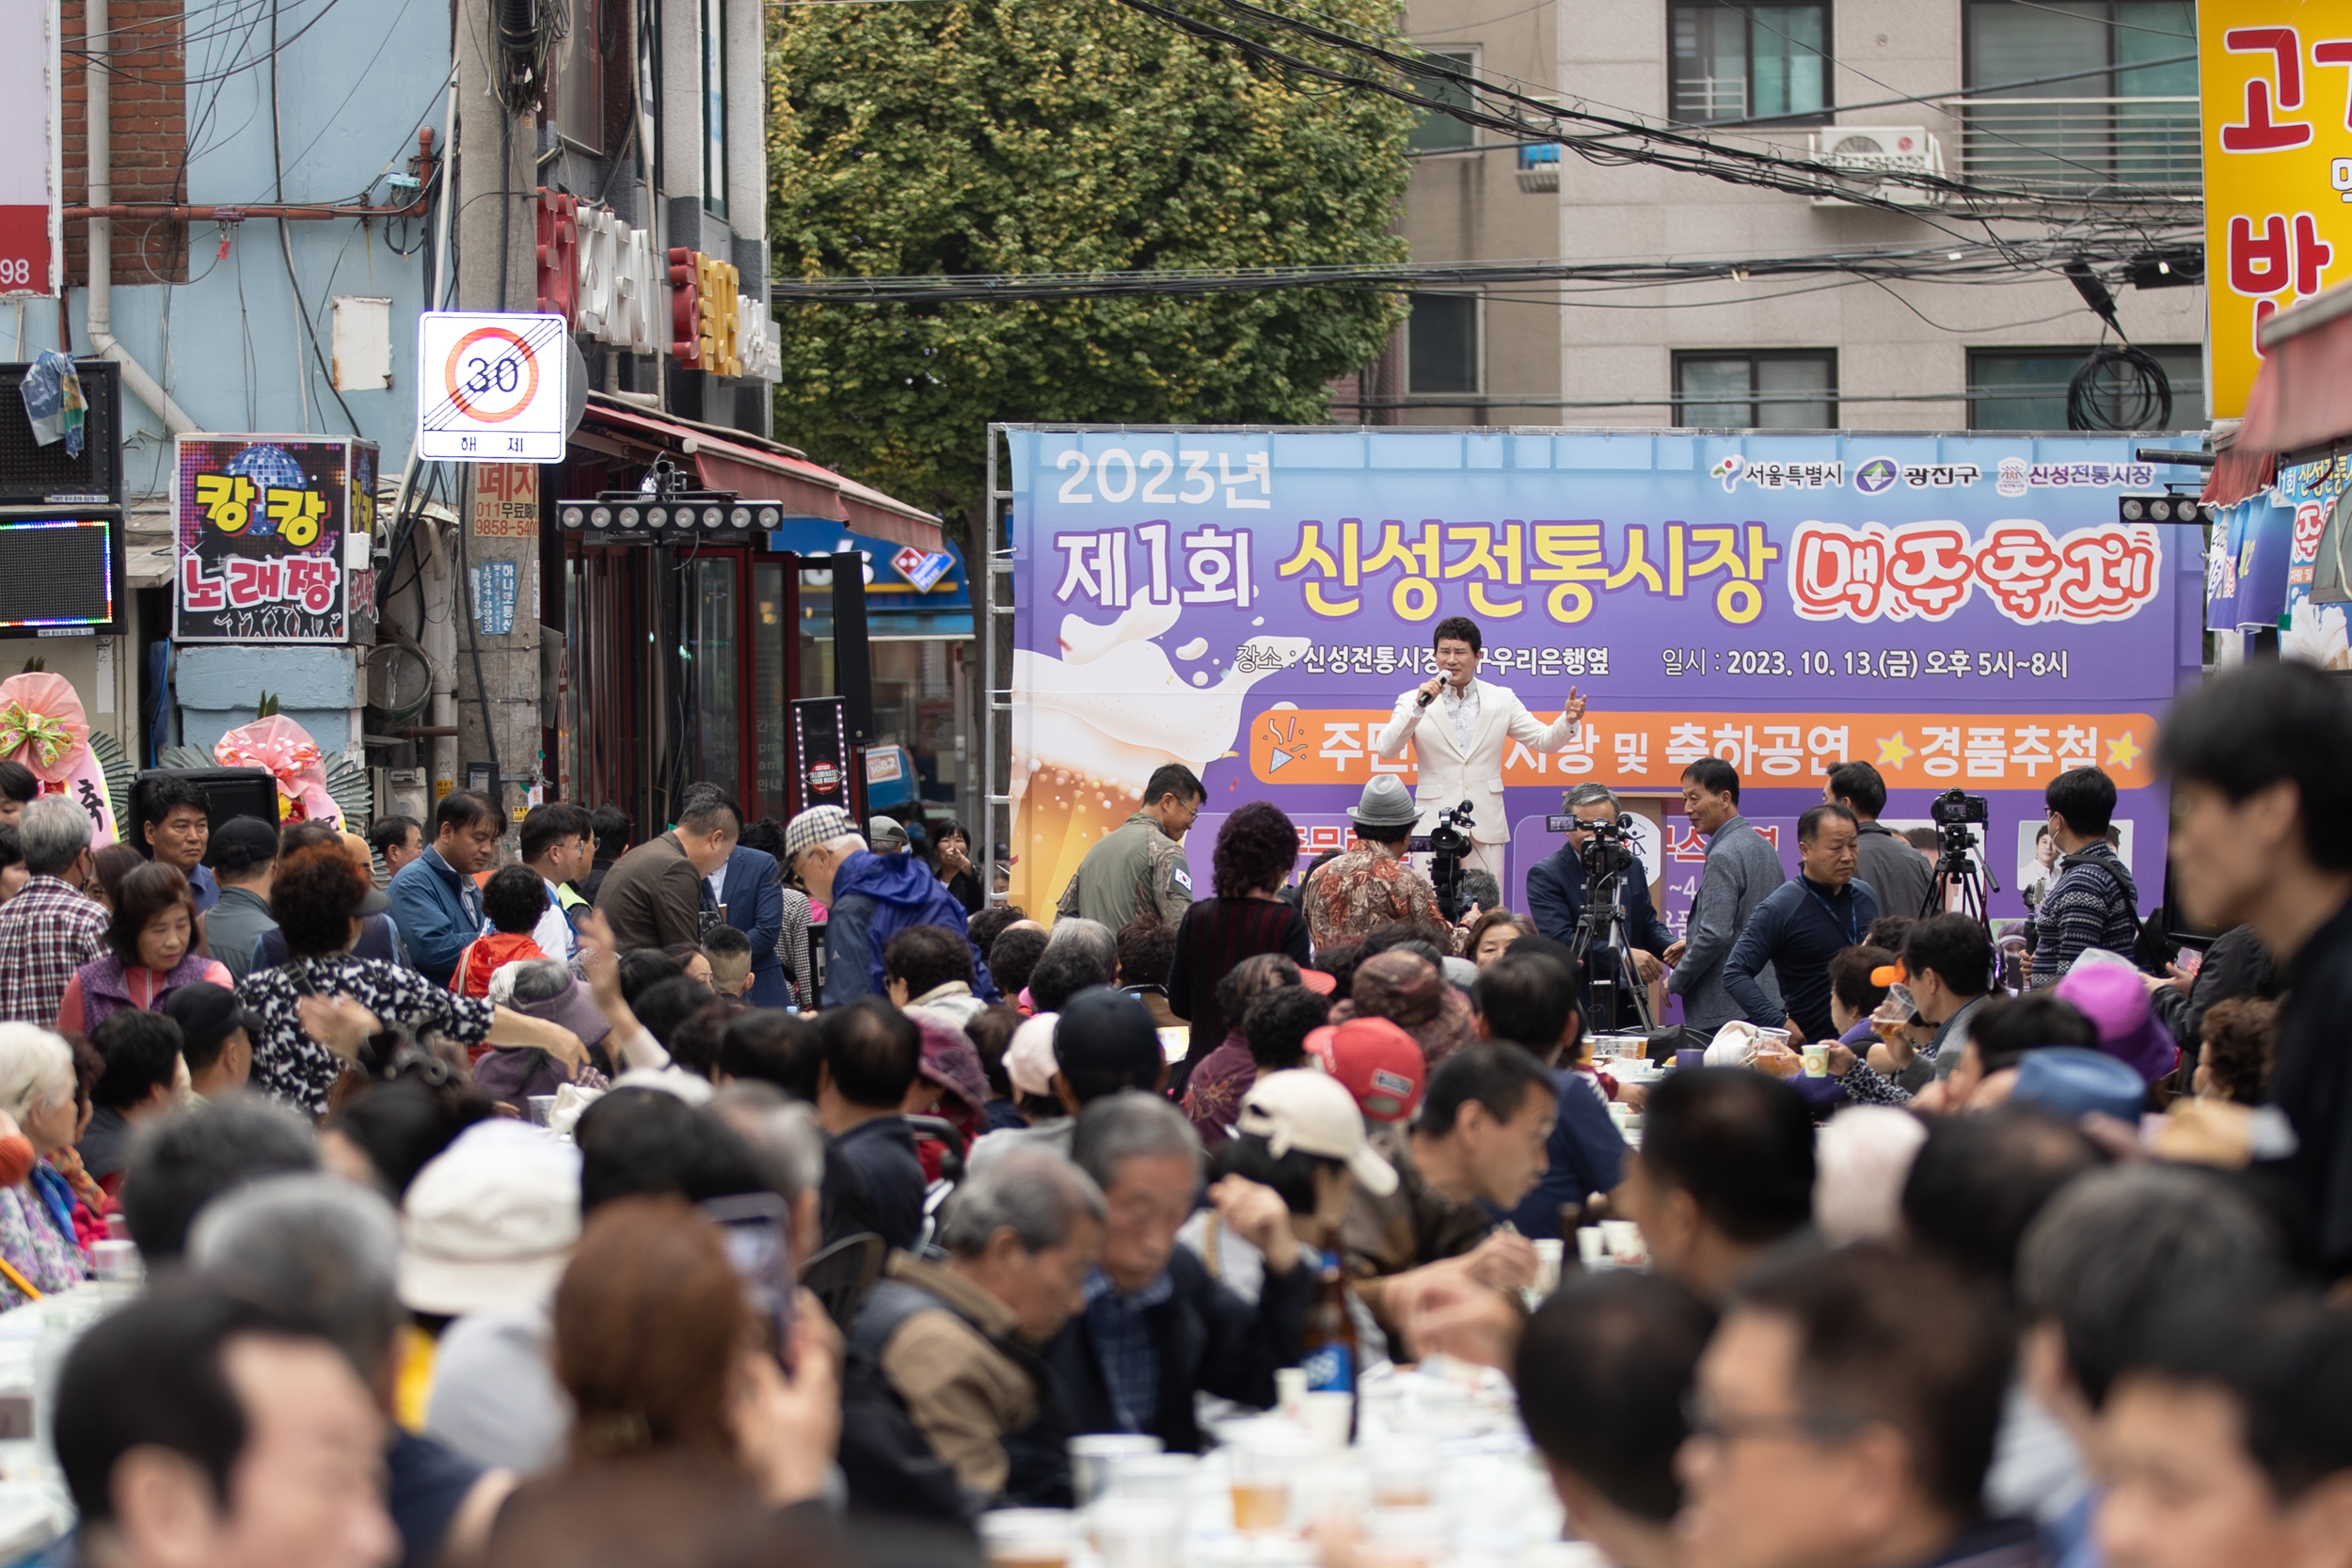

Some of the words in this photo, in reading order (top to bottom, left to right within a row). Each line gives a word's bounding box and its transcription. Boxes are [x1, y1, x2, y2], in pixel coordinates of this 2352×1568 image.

[468, 357, 518, 392] 30
[1056, 448, 1272, 509] 2023년
[1746, 464, 1843, 486] 서울특별시
[1903, 466, 1979, 487] 광진구
[2028, 464, 2153, 487] 신성전통시장
[196, 473, 328, 547] 캉캉
[476, 501, 500, 517] 011
[1055, 522, 1252, 609] 제1회
[1278, 520, 1780, 624] 신성전통시장
[1790, 527, 2156, 617] 맥주축제
[1235, 645, 1283, 673] 장소
[1661, 647, 1706, 676] 일시
[1726, 650, 1793, 677] 2023.
[1800, 650, 1836, 677] 10.
[1924, 649, 1973, 679] 오후
[1978, 649, 2069, 679] 5시~8시
[1614, 733, 1648, 774] 및
[1665, 722, 1850, 776] 축하공연
[1919, 726, 2098, 778] 경품추첨
